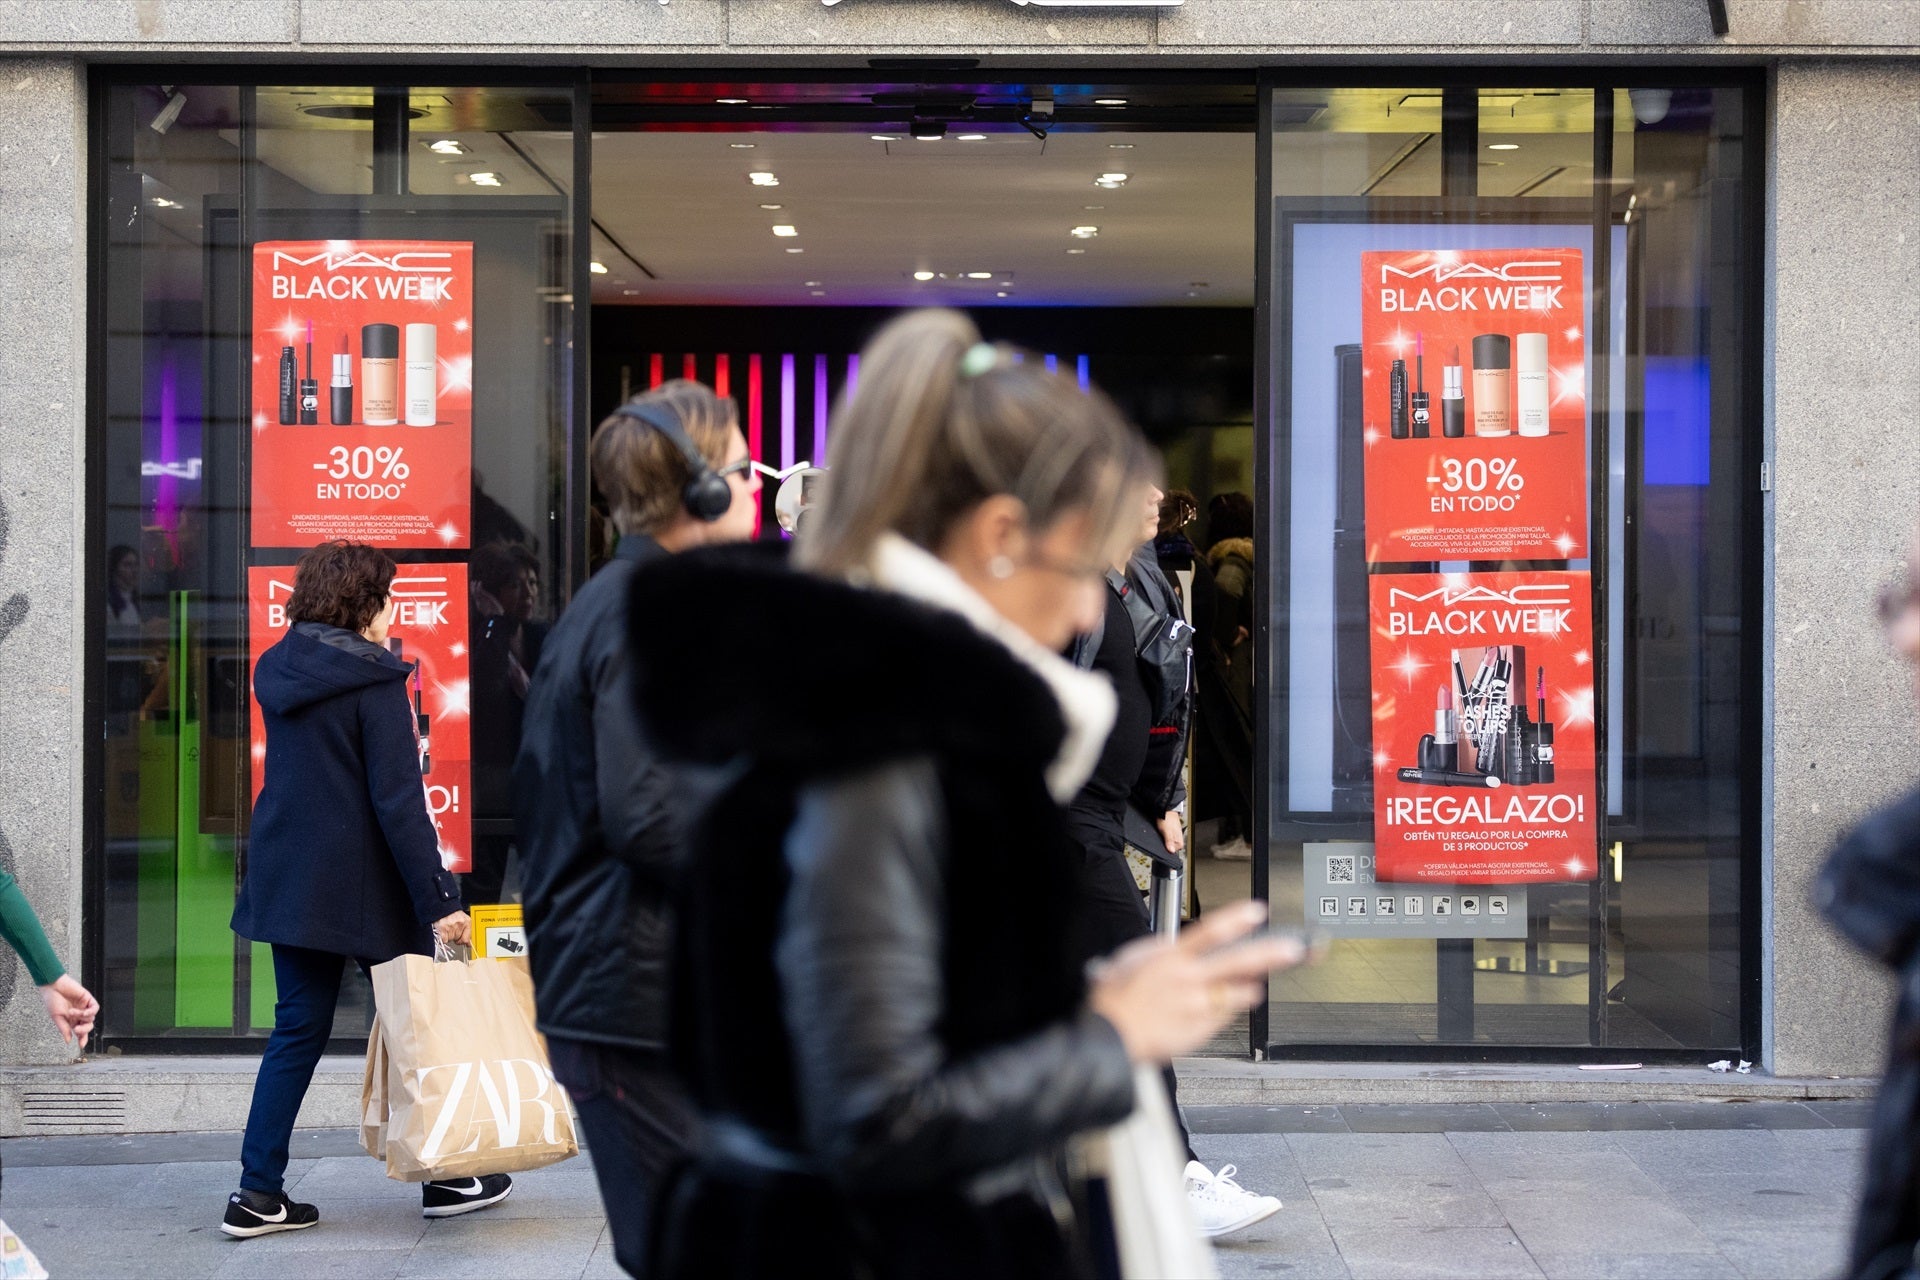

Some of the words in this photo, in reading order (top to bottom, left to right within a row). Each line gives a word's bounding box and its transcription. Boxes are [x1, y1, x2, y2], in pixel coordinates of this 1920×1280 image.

[272, 275, 369, 300] BLACK
[374, 276, 454, 301] WEEK
[1381, 287, 1479, 312] BLACK
[1484, 285, 1564, 311] WEEK
[313, 446, 410, 480] -30%
[1426, 457, 1524, 492] -30%
[316, 483, 340, 500] EN
[1430, 497, 1454, 513] EN
[1480, 532, 1516, 540] PROMOCIÓN
[1389, 610, 1487, 635] BLACK
[1492, 609, 1572, 633] WEEK
[1386, 794, 1585, 826] ¡REGALAZO!
[1403, 830, 1435, 841] OBTÉN
[1437, 832, 1449, 840] TU
[1451, 832, 1489, 840] REGALO
[1490, 831, 1510, 840] POR
[1512, 831, 1524, 839] LA
[1525, 830, 1568, 839] COMPRA
[1443, 843, 1456, 851] DE
[1457, 843, 1463, 851] 3
[1448, 862, 1468, 870] VÁLIDA
[416, 1058, 578, 1160] ZARA
